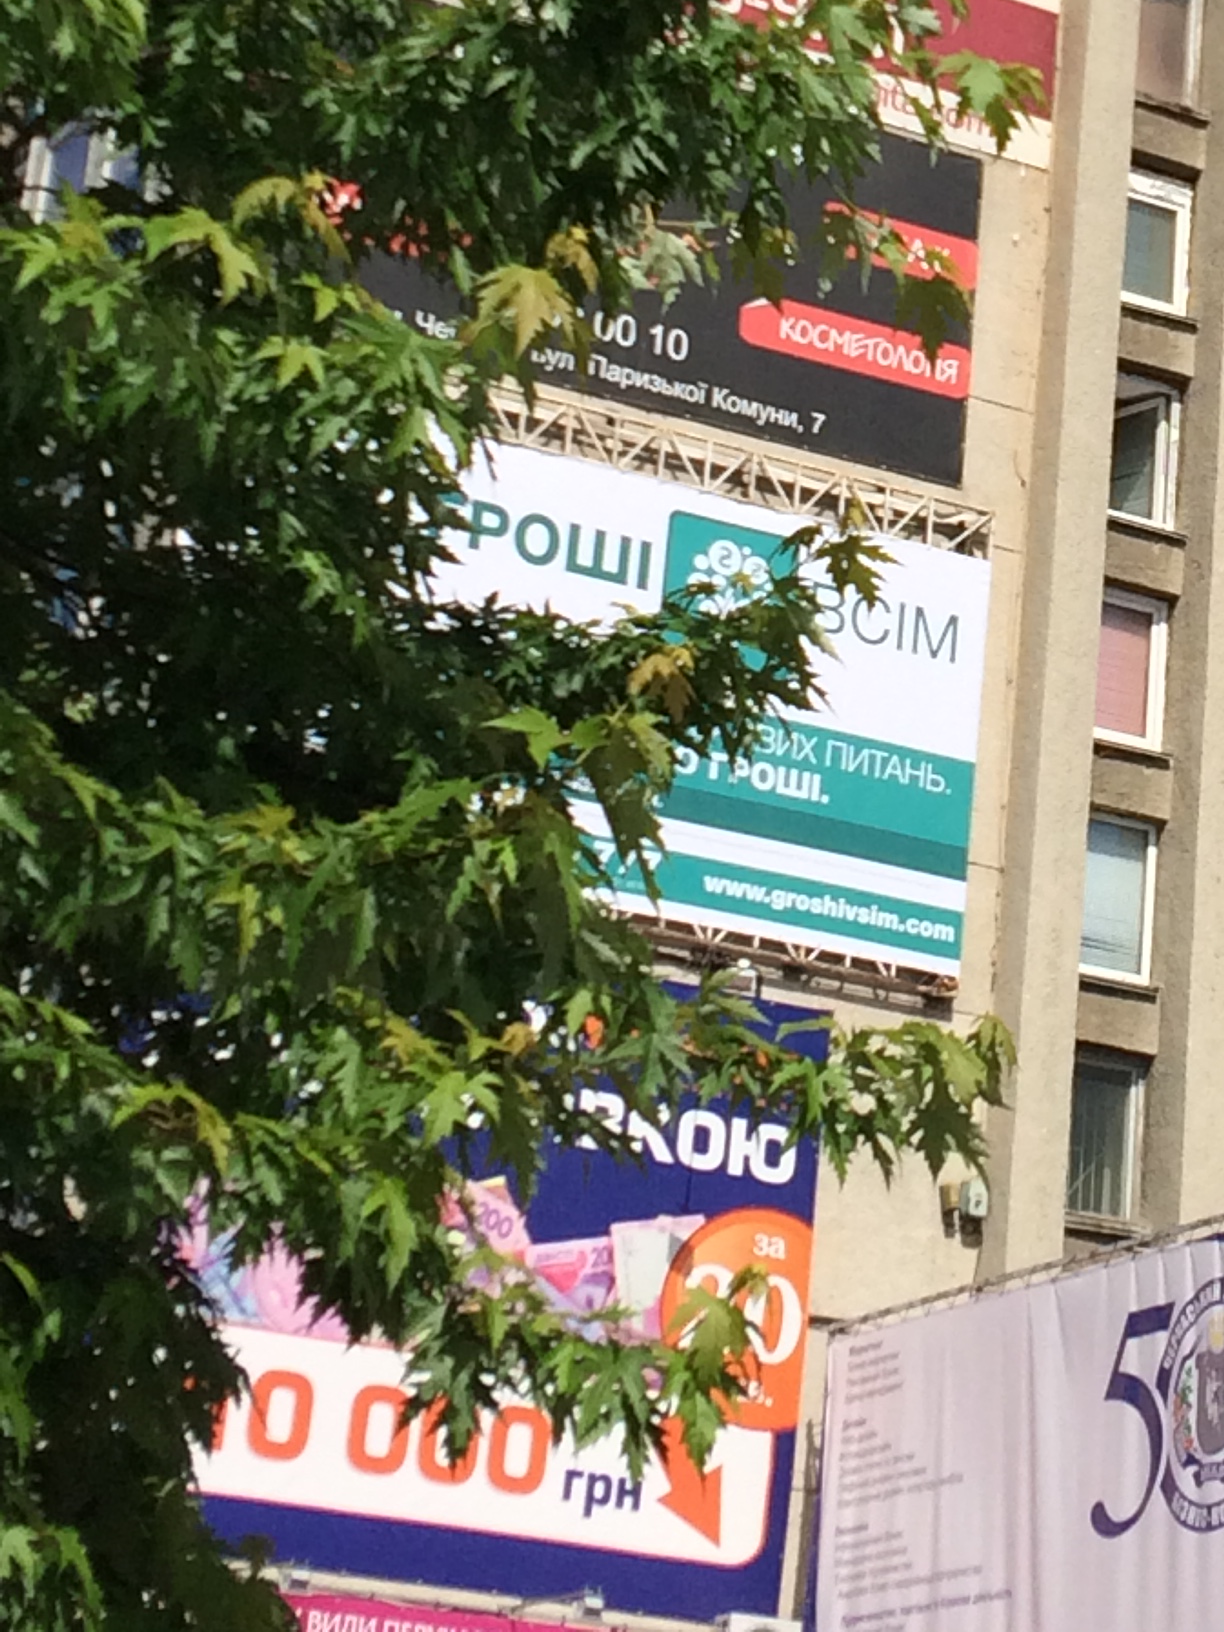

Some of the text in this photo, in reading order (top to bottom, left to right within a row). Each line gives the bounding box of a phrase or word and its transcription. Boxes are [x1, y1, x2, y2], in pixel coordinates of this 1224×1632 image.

[650, 323, 689, 361] 10
[587, 354, 706, 405] Паризької
[711, 386, 803, 434] Комуни,
[810, 411, 827, 434] 7
[825, 739, 952, 795] ПИТАНЬ.
[704, 875, 955, 943] www.groshivsim.com
[753, 1233, 786, 1260] за
[563, 1467, 643, 1519] грн
